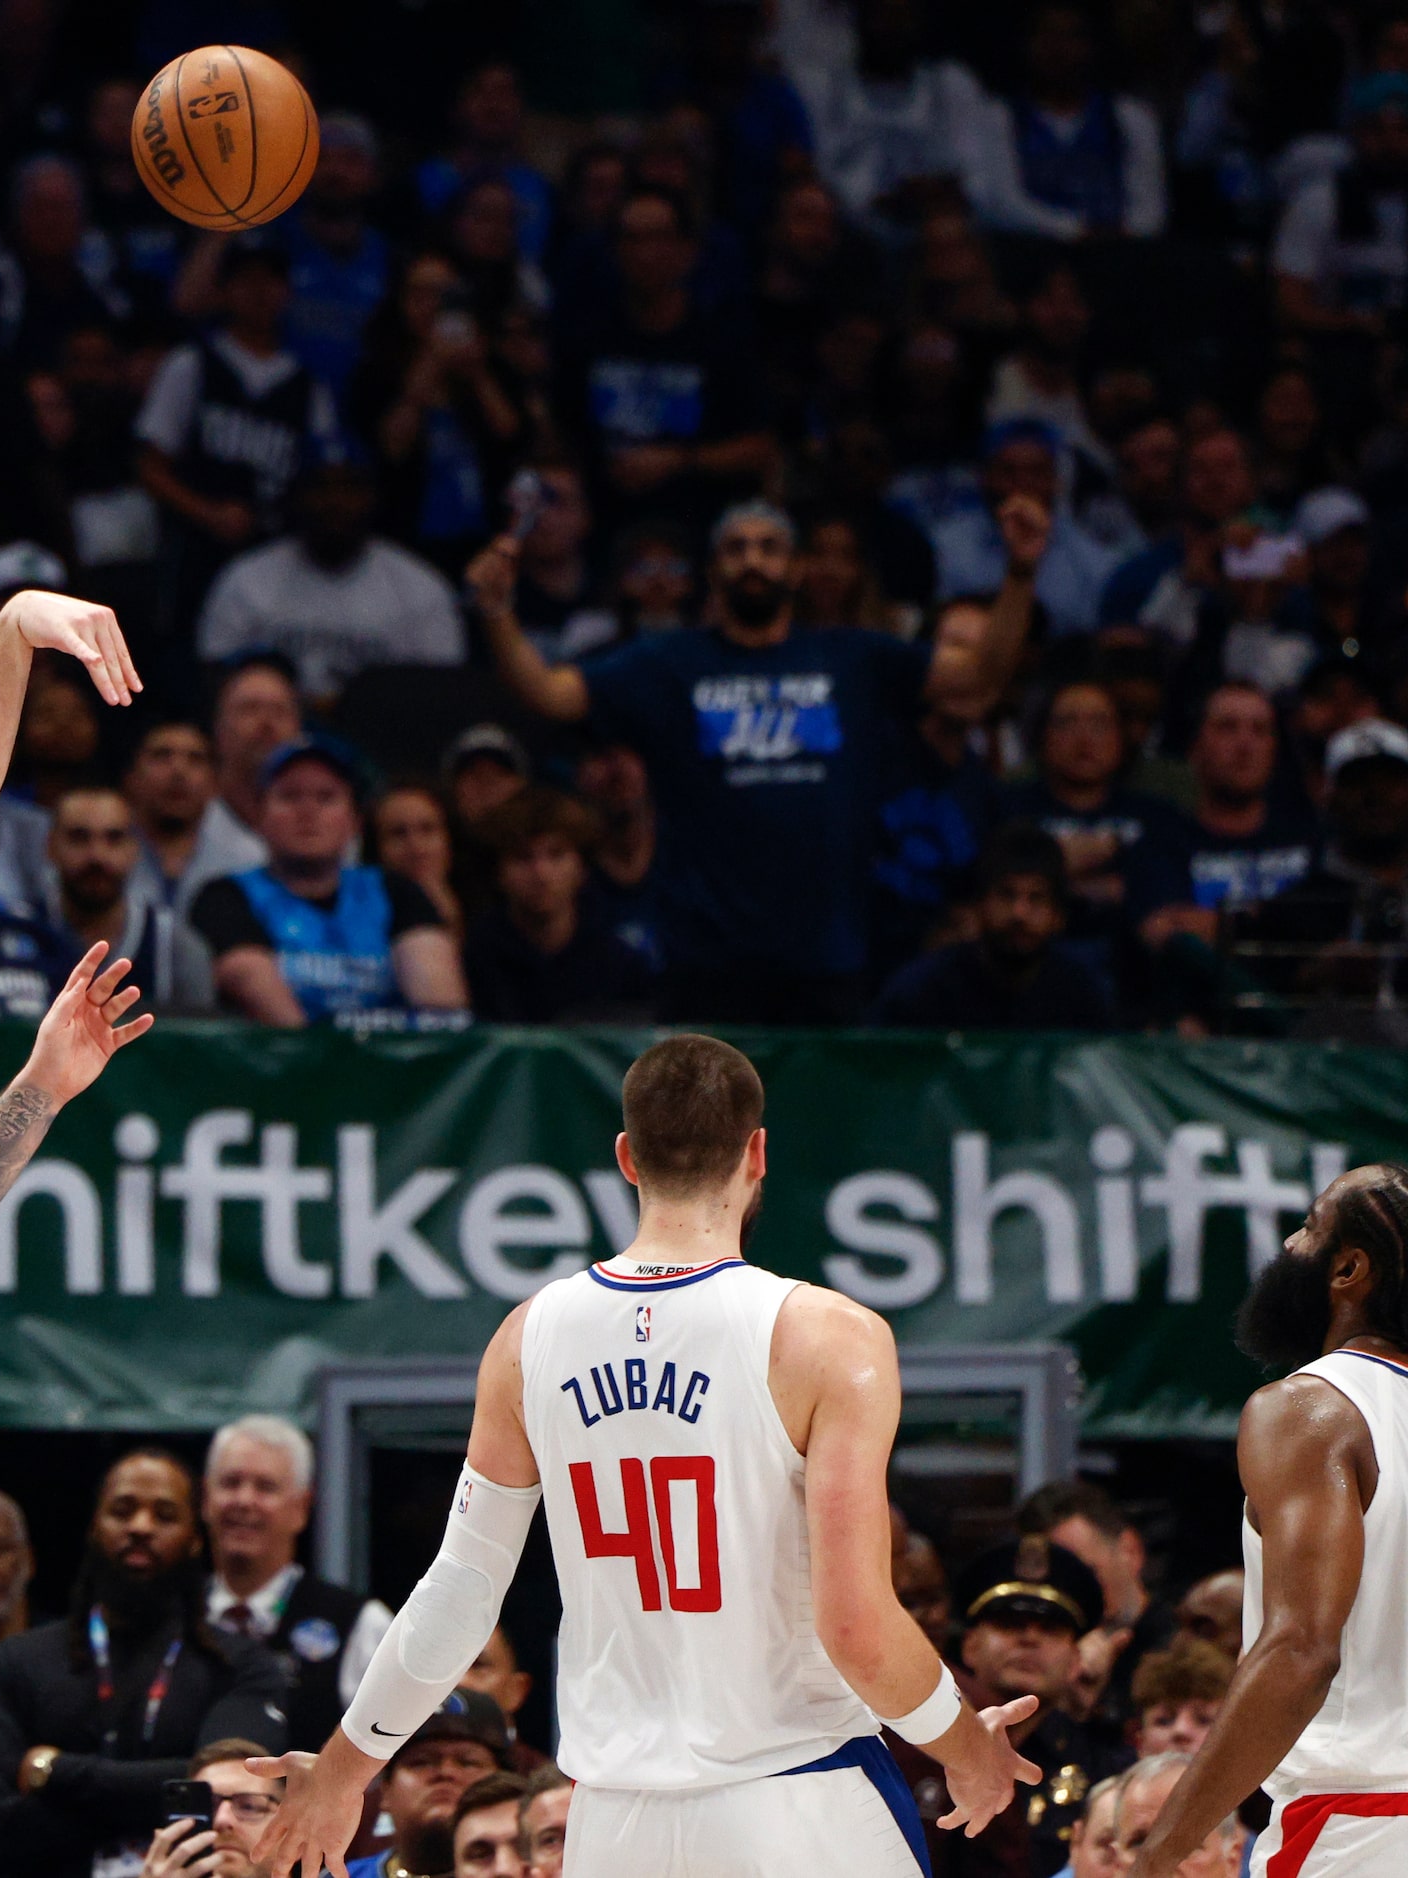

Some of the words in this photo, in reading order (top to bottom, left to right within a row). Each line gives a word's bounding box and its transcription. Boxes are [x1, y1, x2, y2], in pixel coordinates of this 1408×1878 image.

[634, 1265, 665, 1276] NIKE
[822, 1122, 1352, 1309] shift
[560, 1358, 711, 1429] ZUBAC
[568, 1455, 722, 1612] 40
